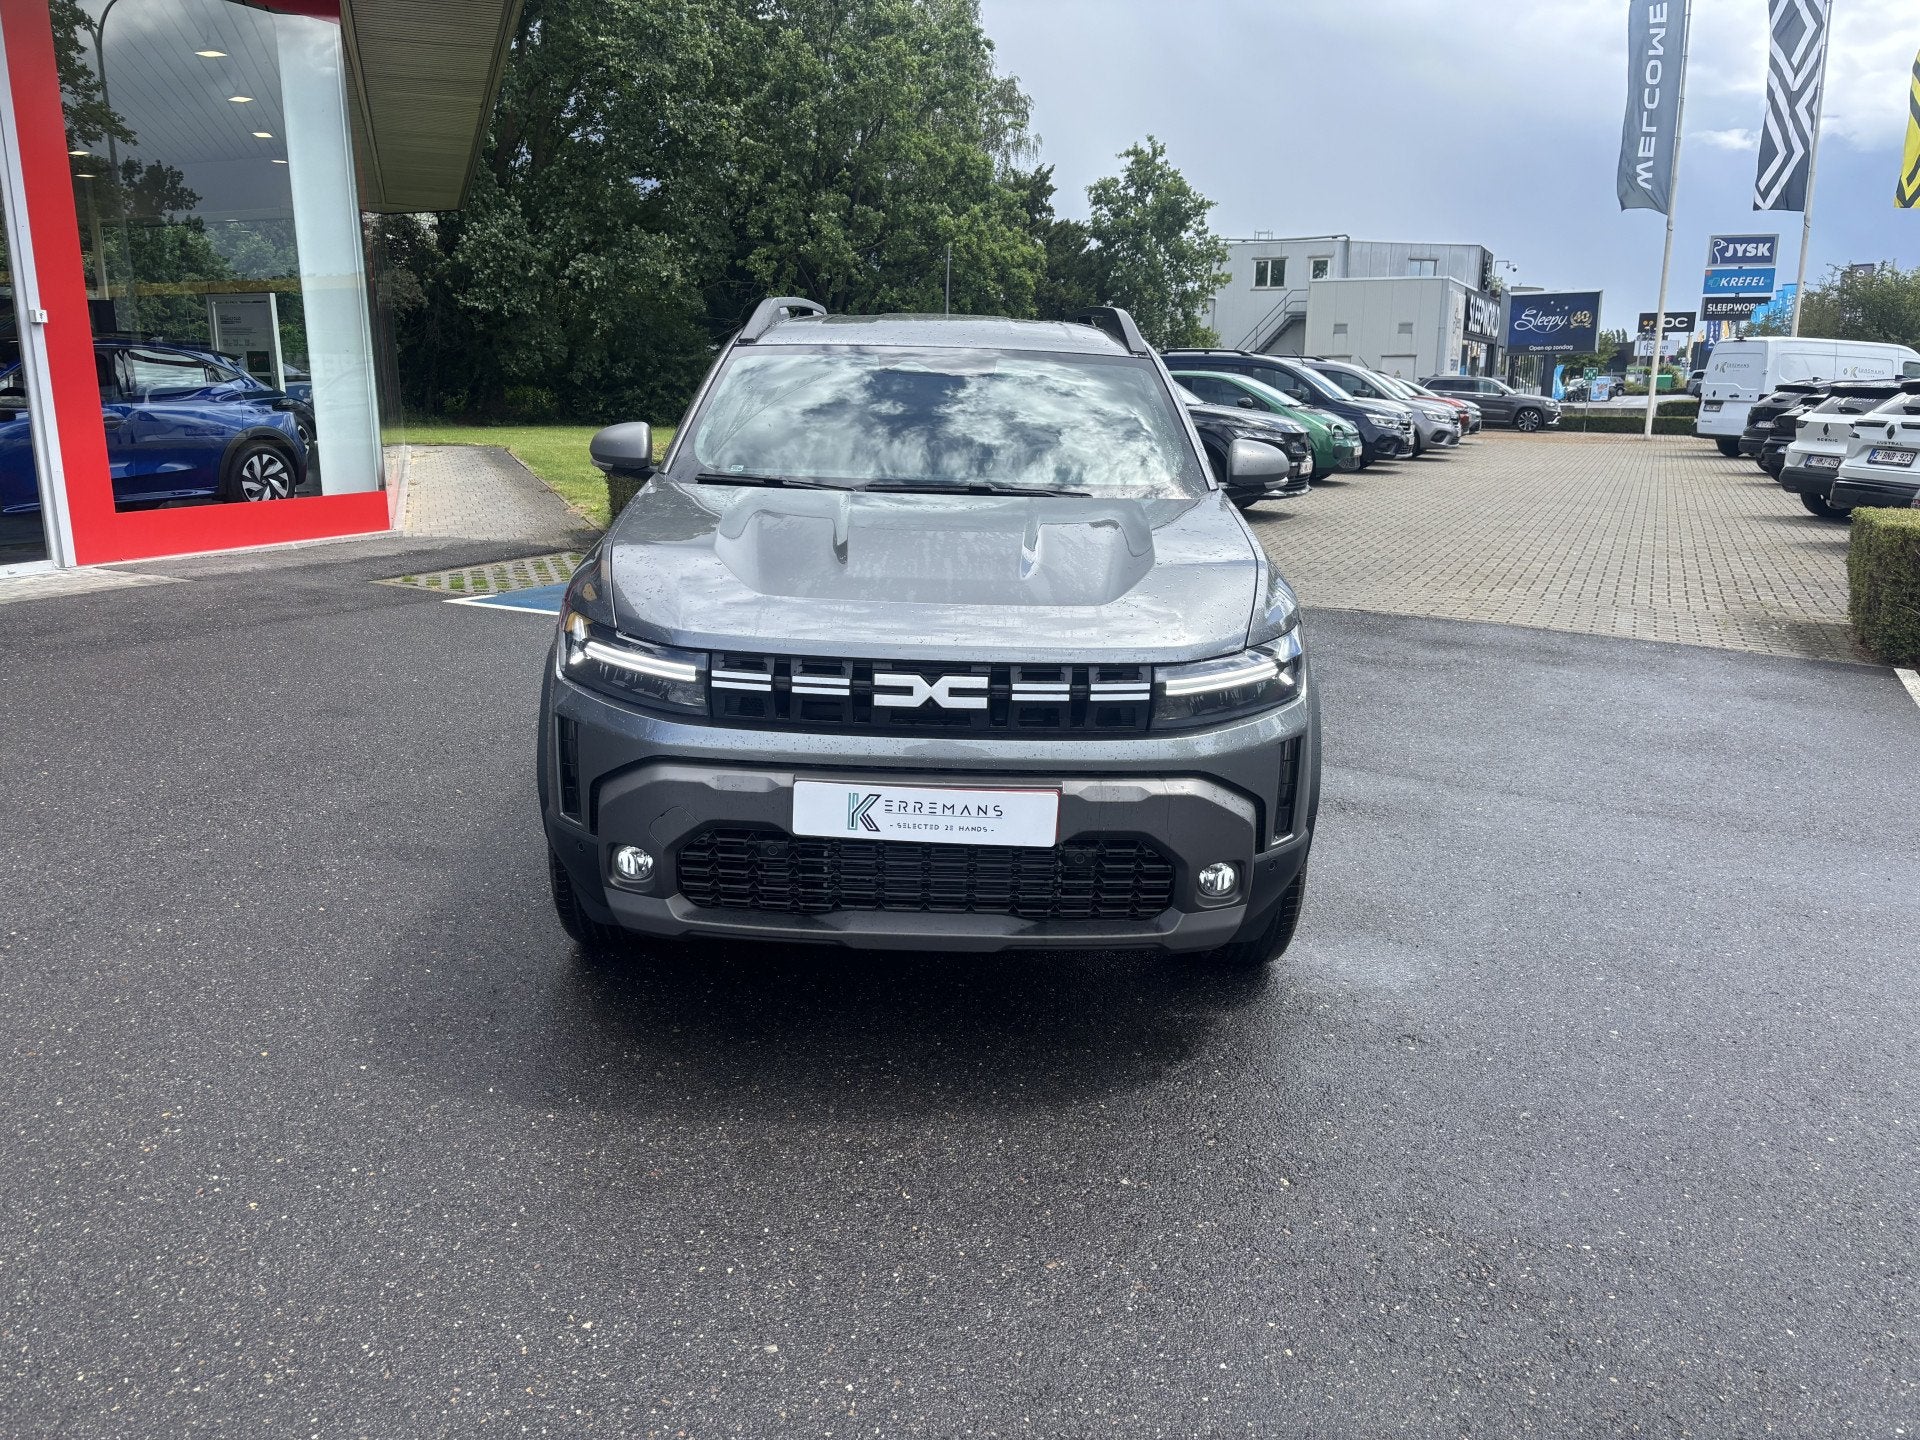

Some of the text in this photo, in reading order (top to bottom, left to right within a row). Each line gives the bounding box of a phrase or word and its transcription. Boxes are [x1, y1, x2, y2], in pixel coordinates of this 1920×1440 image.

[1724, 243, 1771, 257] JYSK
[1514, 306, 1568, 333] Sleepy
[897, 822, 940, 831] SELECTED
